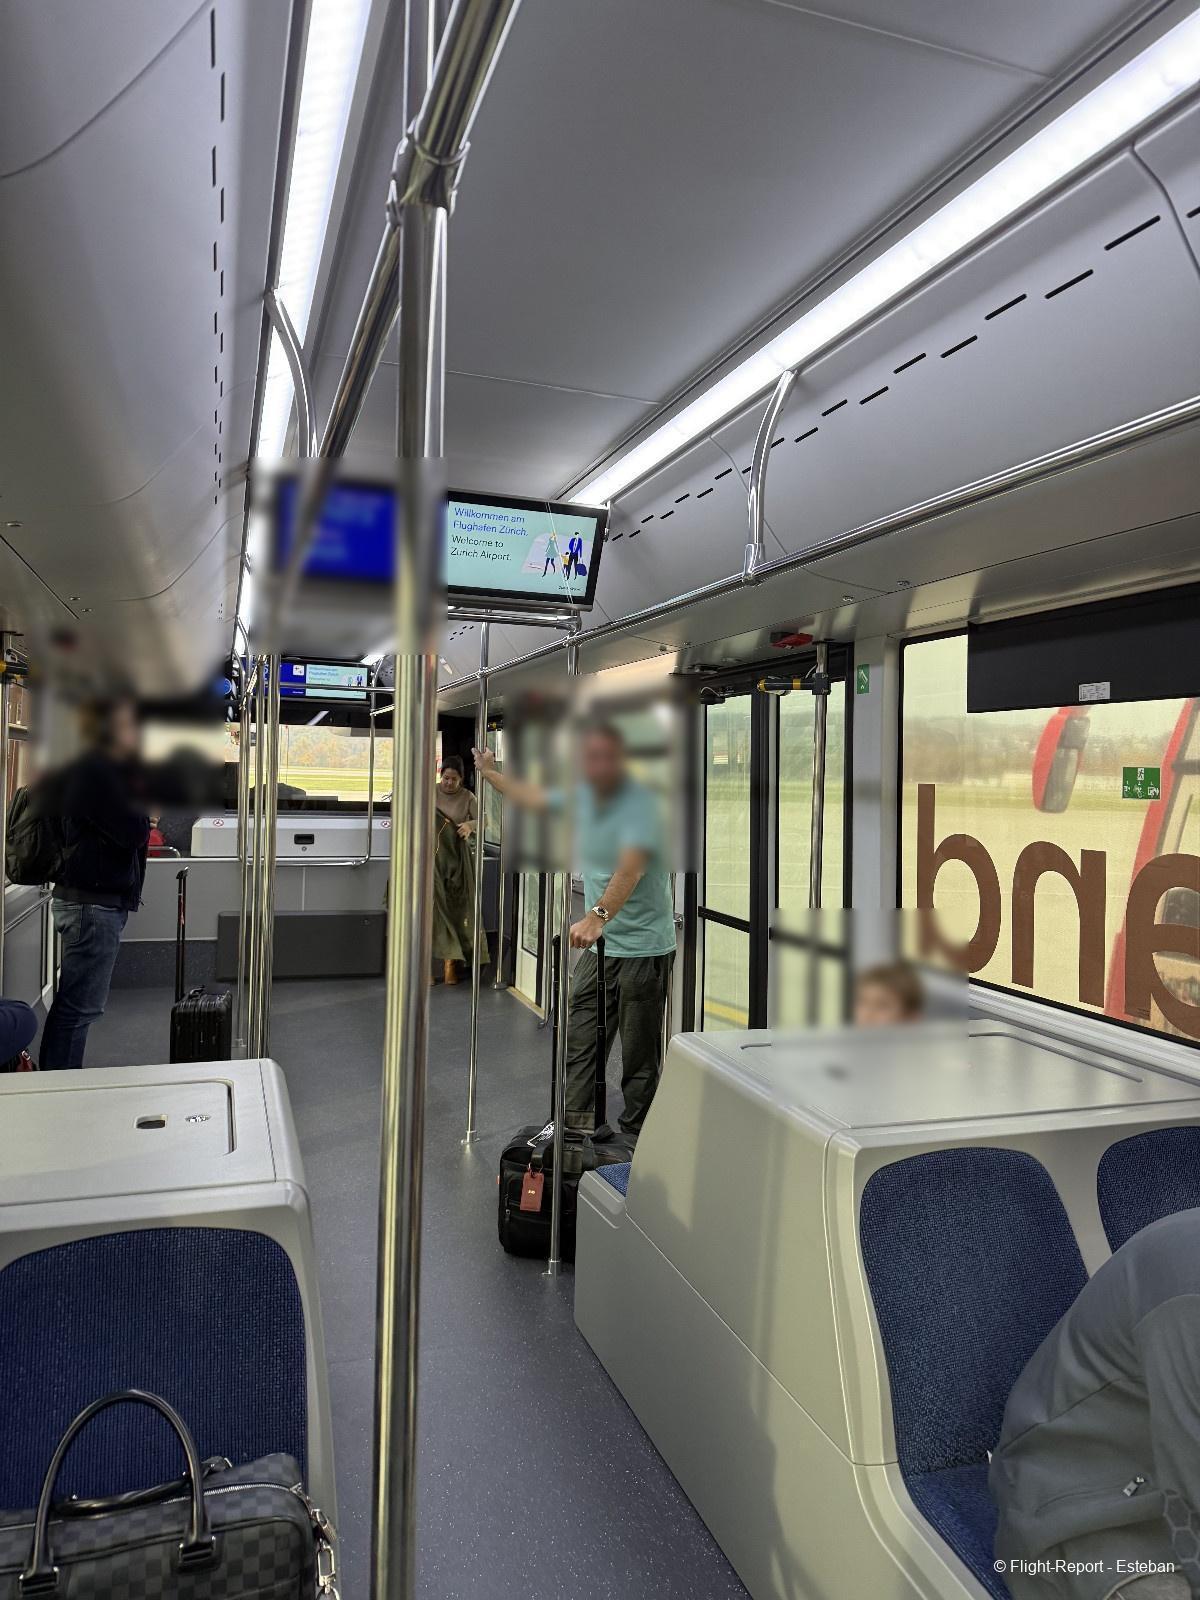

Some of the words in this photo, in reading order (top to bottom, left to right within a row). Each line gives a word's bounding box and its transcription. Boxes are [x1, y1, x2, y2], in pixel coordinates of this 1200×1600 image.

[454, 507, 508, 521] Willkommen
[453, 520, 497, 532] Flughafen
[452, 534, 493, 546] Welcome
[495, 540, 504, 548] to
